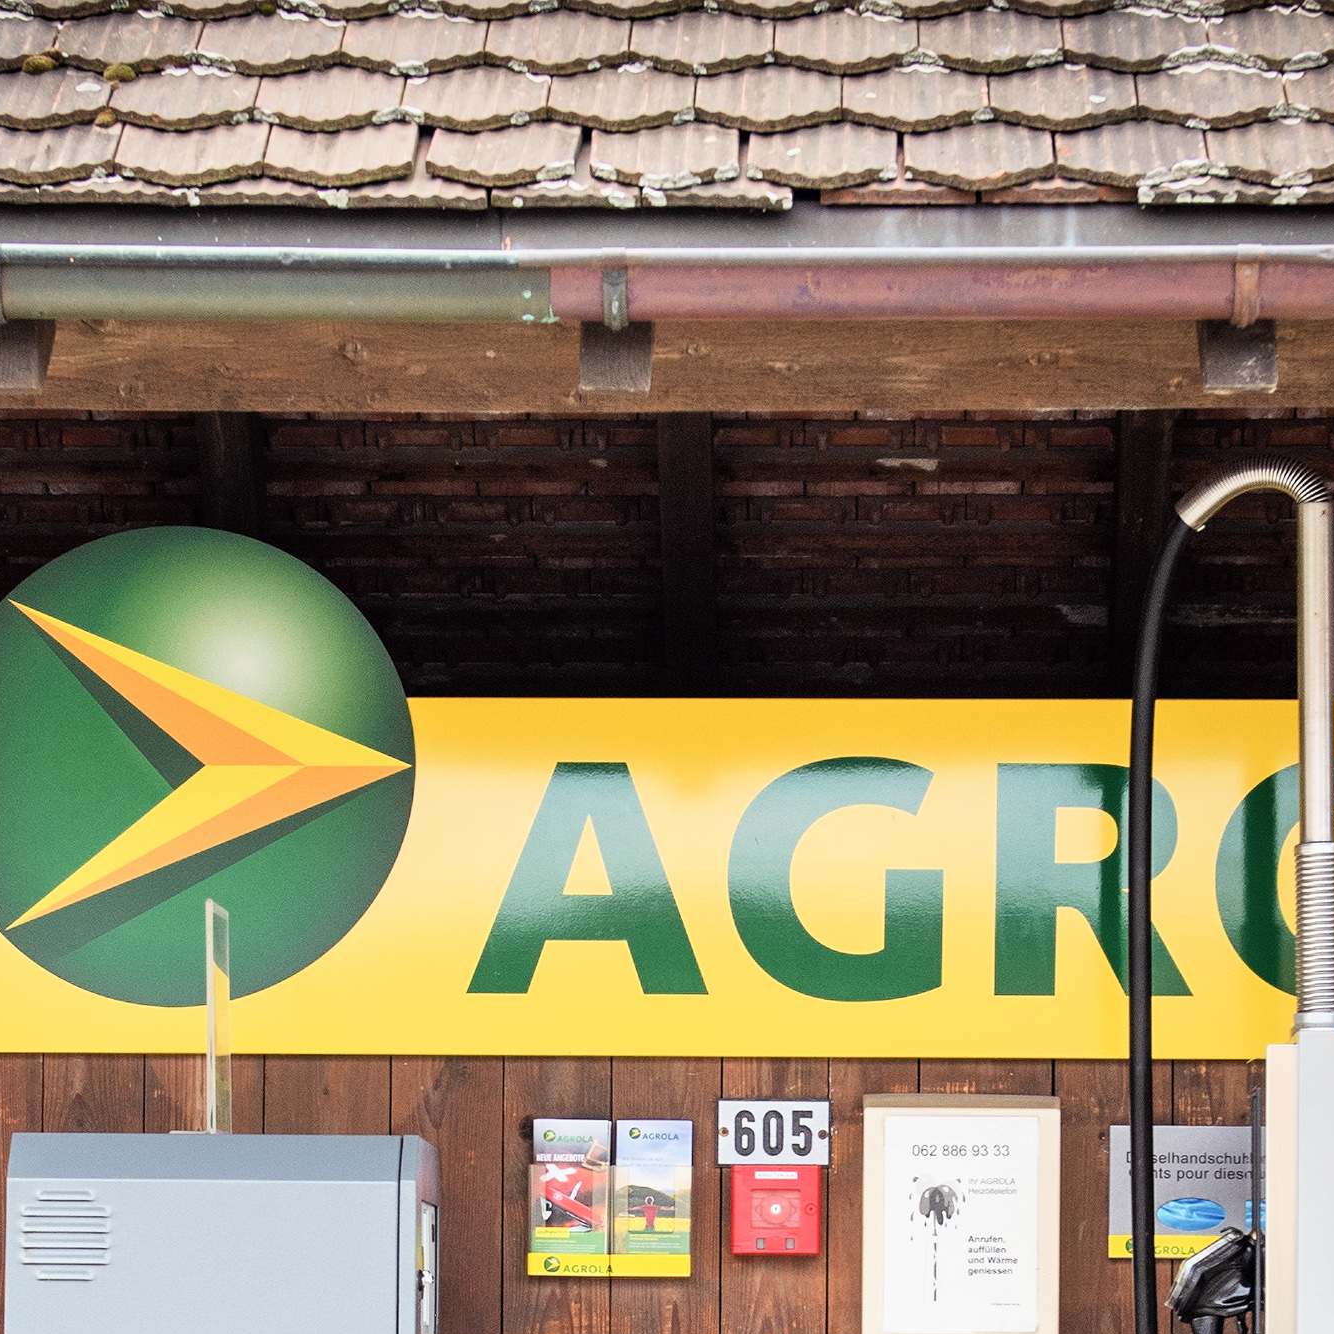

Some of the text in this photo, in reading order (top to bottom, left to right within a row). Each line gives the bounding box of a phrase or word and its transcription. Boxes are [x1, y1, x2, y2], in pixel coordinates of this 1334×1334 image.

[734, 1110, 813, 1157] 605
[557, 1135, 594, 1143] AGROLA
[912, 1144, 1010, 1157] 062 886 93 33
[1177, 1169, 1209, 1181] pour
[968, 1235, 1006, 1243] Anrufen,
[968, 1246, 1007, 1254] auffüllen
[1154, 1245, 1196, 1255] GROLA
[968, 1256, 1019, 1264] und Wärme
[563, 1264, 614, 1274] AGROLA
[968, 1267, 1013, 1277] geniessen
